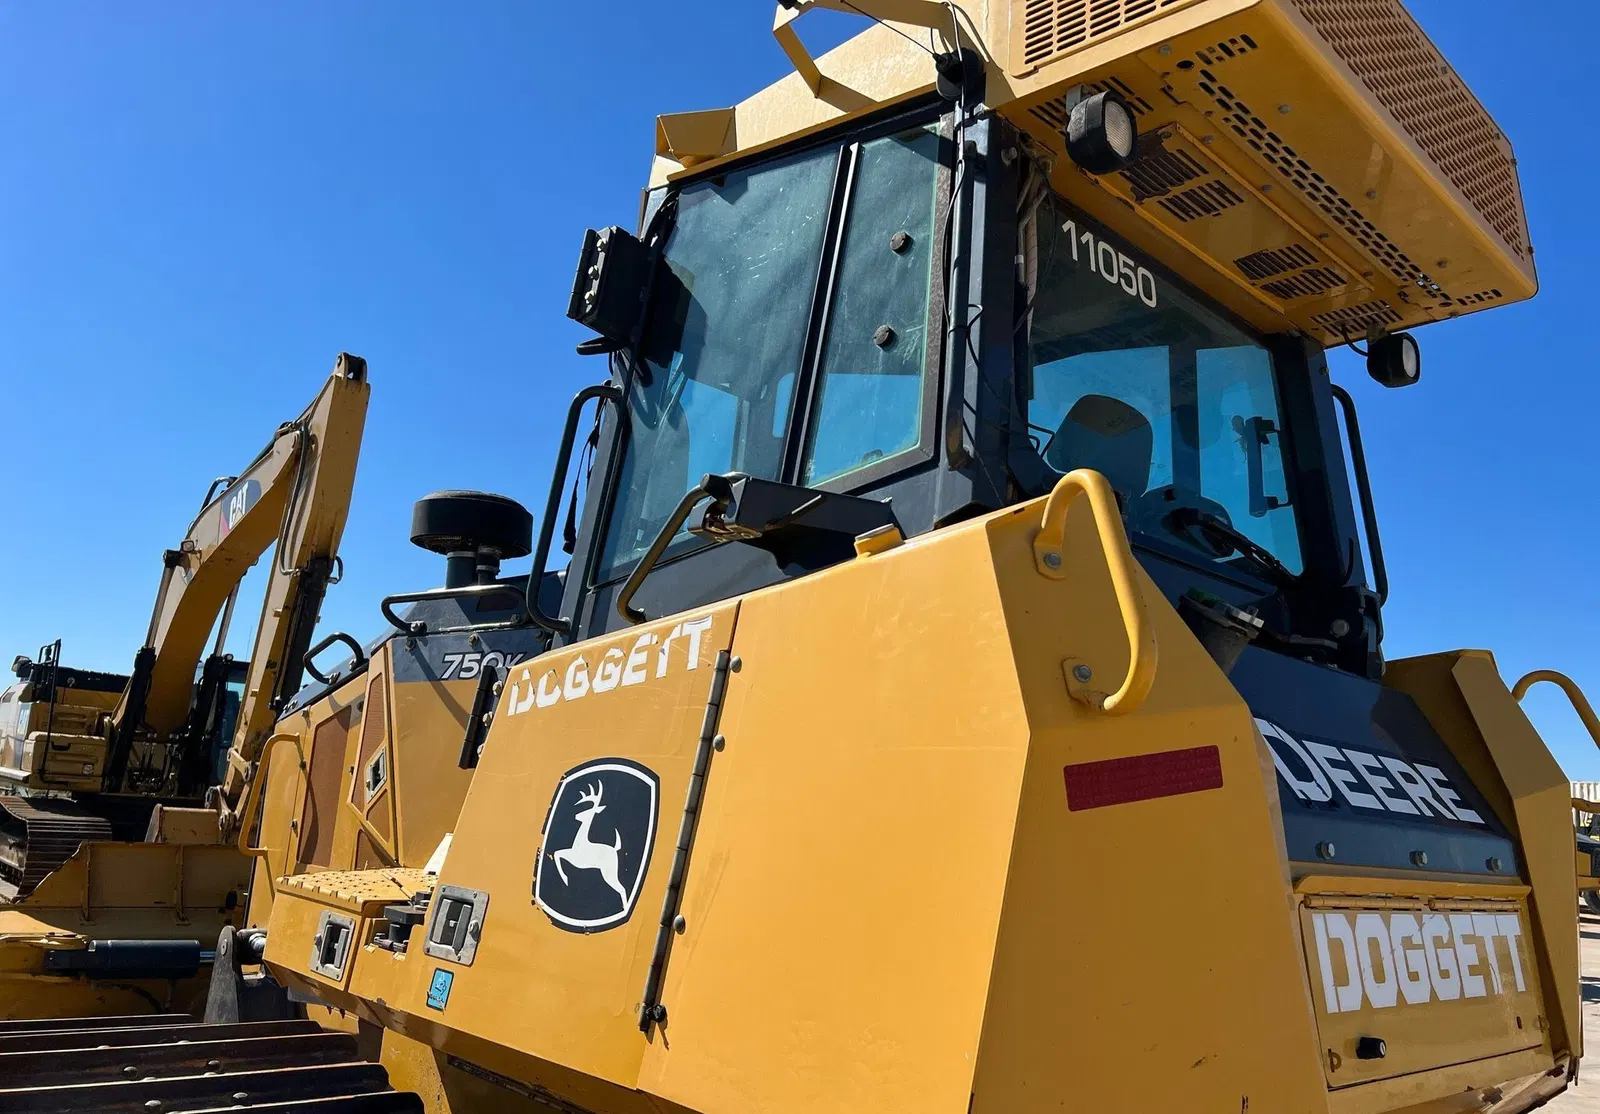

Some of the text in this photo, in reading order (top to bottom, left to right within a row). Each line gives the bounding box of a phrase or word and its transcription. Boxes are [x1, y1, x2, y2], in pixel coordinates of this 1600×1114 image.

[1061, 219, 1157, 308] 11050
[229, 481, 249, 530] CAT
[1252, 717, 1486, 824] DEERE
[1311, 912, 1526, 1014] DOGGETT
